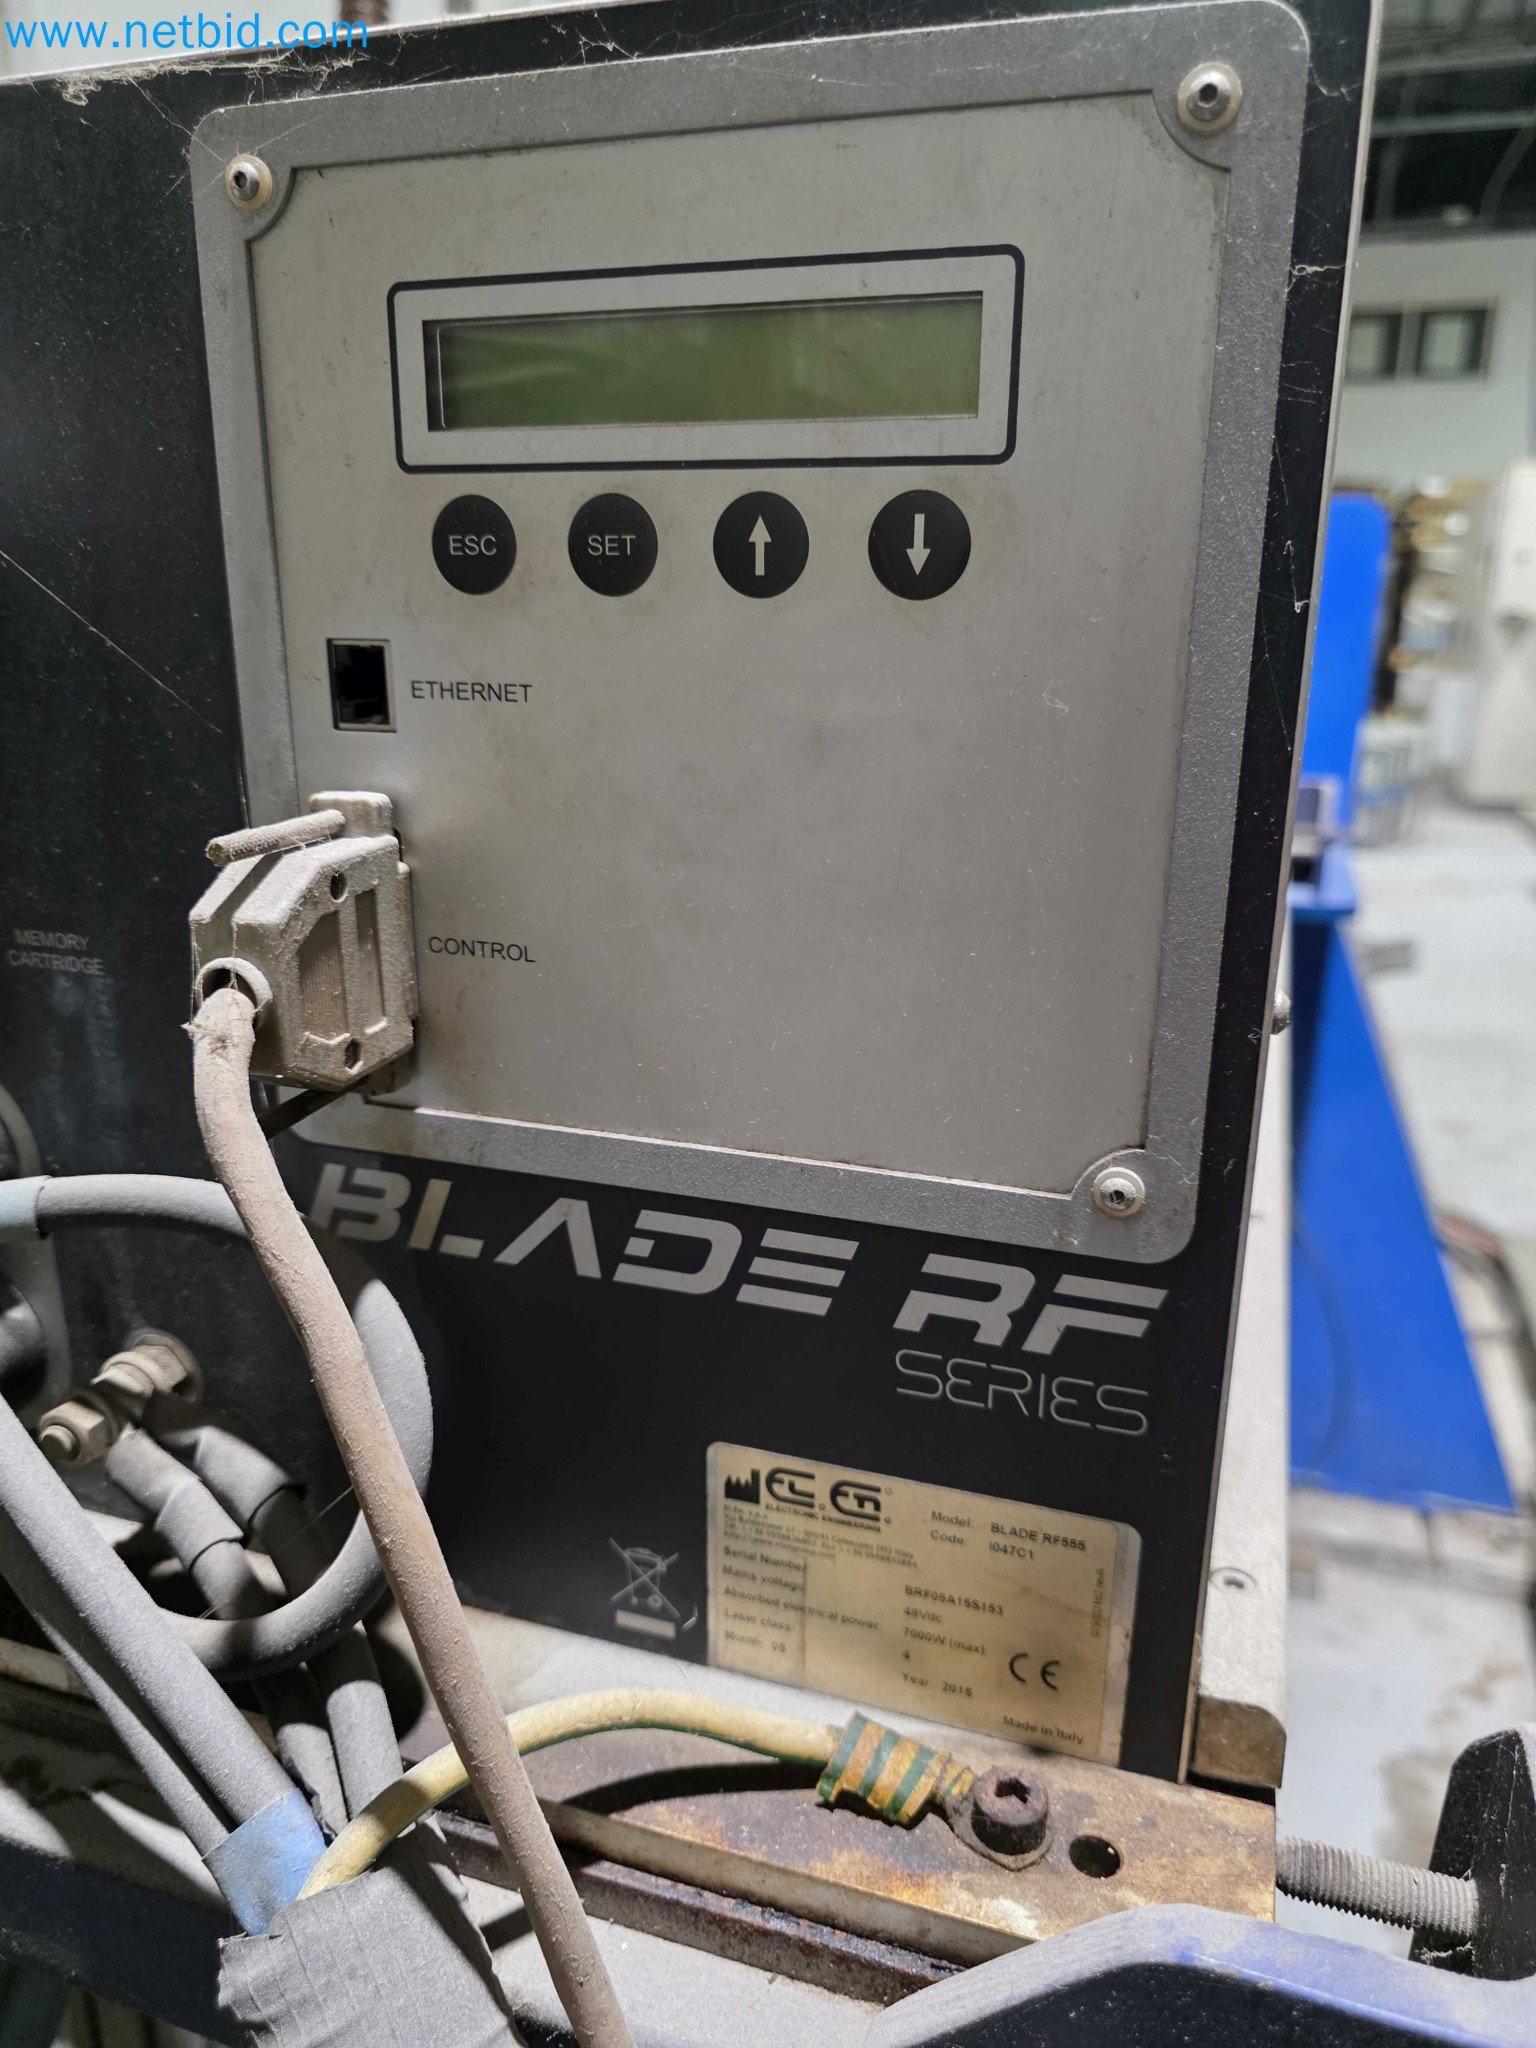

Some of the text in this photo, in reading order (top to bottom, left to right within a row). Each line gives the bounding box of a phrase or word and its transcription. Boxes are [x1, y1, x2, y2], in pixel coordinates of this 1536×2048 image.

[448, 535, 497, 557] ESC
[587, 534, 636, 557] SET
[410, 680, 533, 703] ETHERNET
[14, 928, 90, 950] MEMORY
[428, 936, 536, 963] CONTROL
[8, 950, 106, 976] CARTRIDGE
[308, 1162, 1168, 1355] BLADE RF
[895, 1349, 1149, 1435] SERIES
[991, 1522, 1038, 1541] BLADE
[1003, 1715, 1084, 1745] Made in Italy
